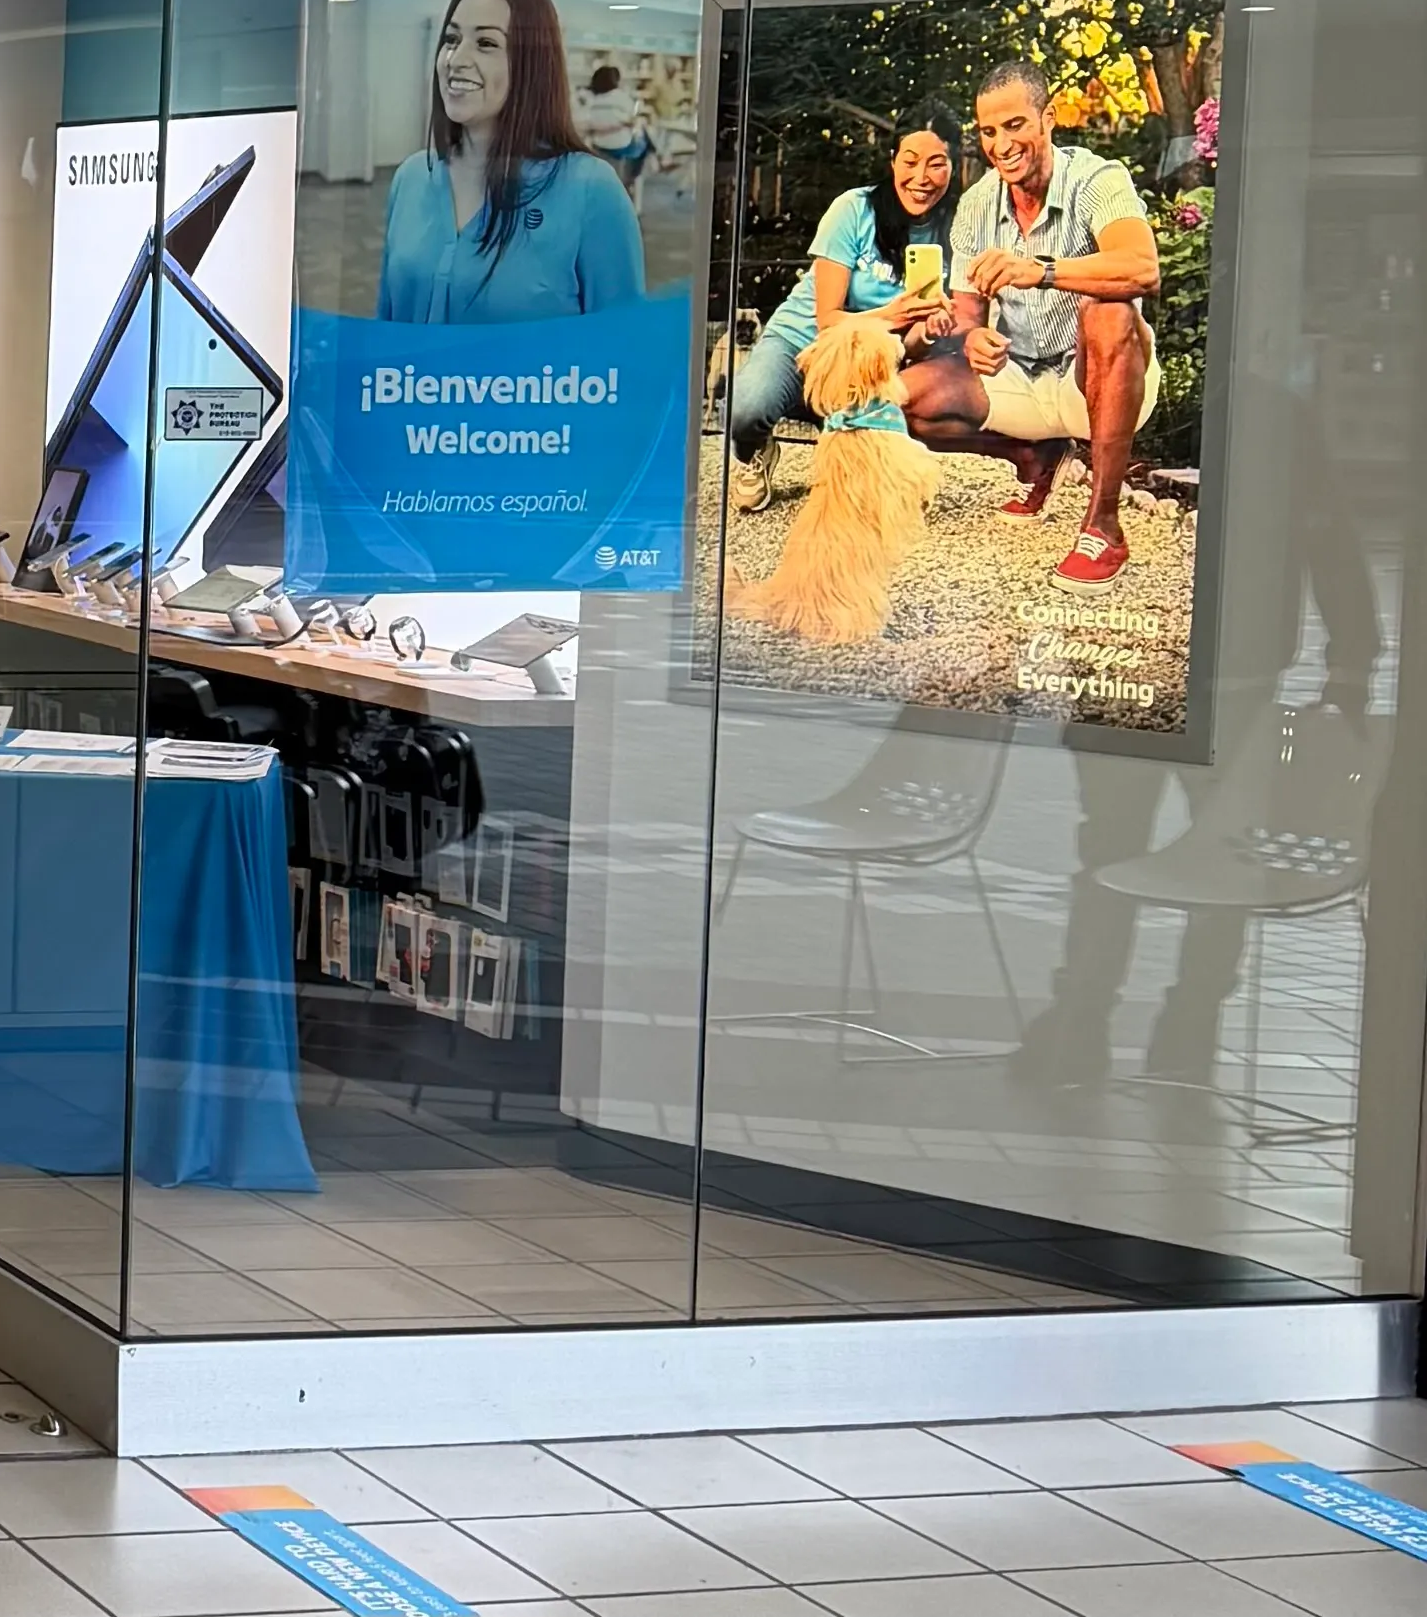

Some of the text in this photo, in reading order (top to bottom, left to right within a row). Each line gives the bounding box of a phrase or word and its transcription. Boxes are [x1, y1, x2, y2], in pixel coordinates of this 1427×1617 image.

[68, 151, 155, 186] SAMSUNG
[361, 364, 618, 412] ¡Bienvenido!
[406, 422, 571, 455] Welcome!
[382, 489, 496, 514] Hablamos
[619, 550, 662, 566] AT&T
[1016, 600, 1160, 639] Connecting
[1028, 633, 1144, 671] Changes
[1017, 666, 1155, 708] Everything
[284, 1544, 317, 1560] TO
[307, 1560, 361, 1590] HARD
